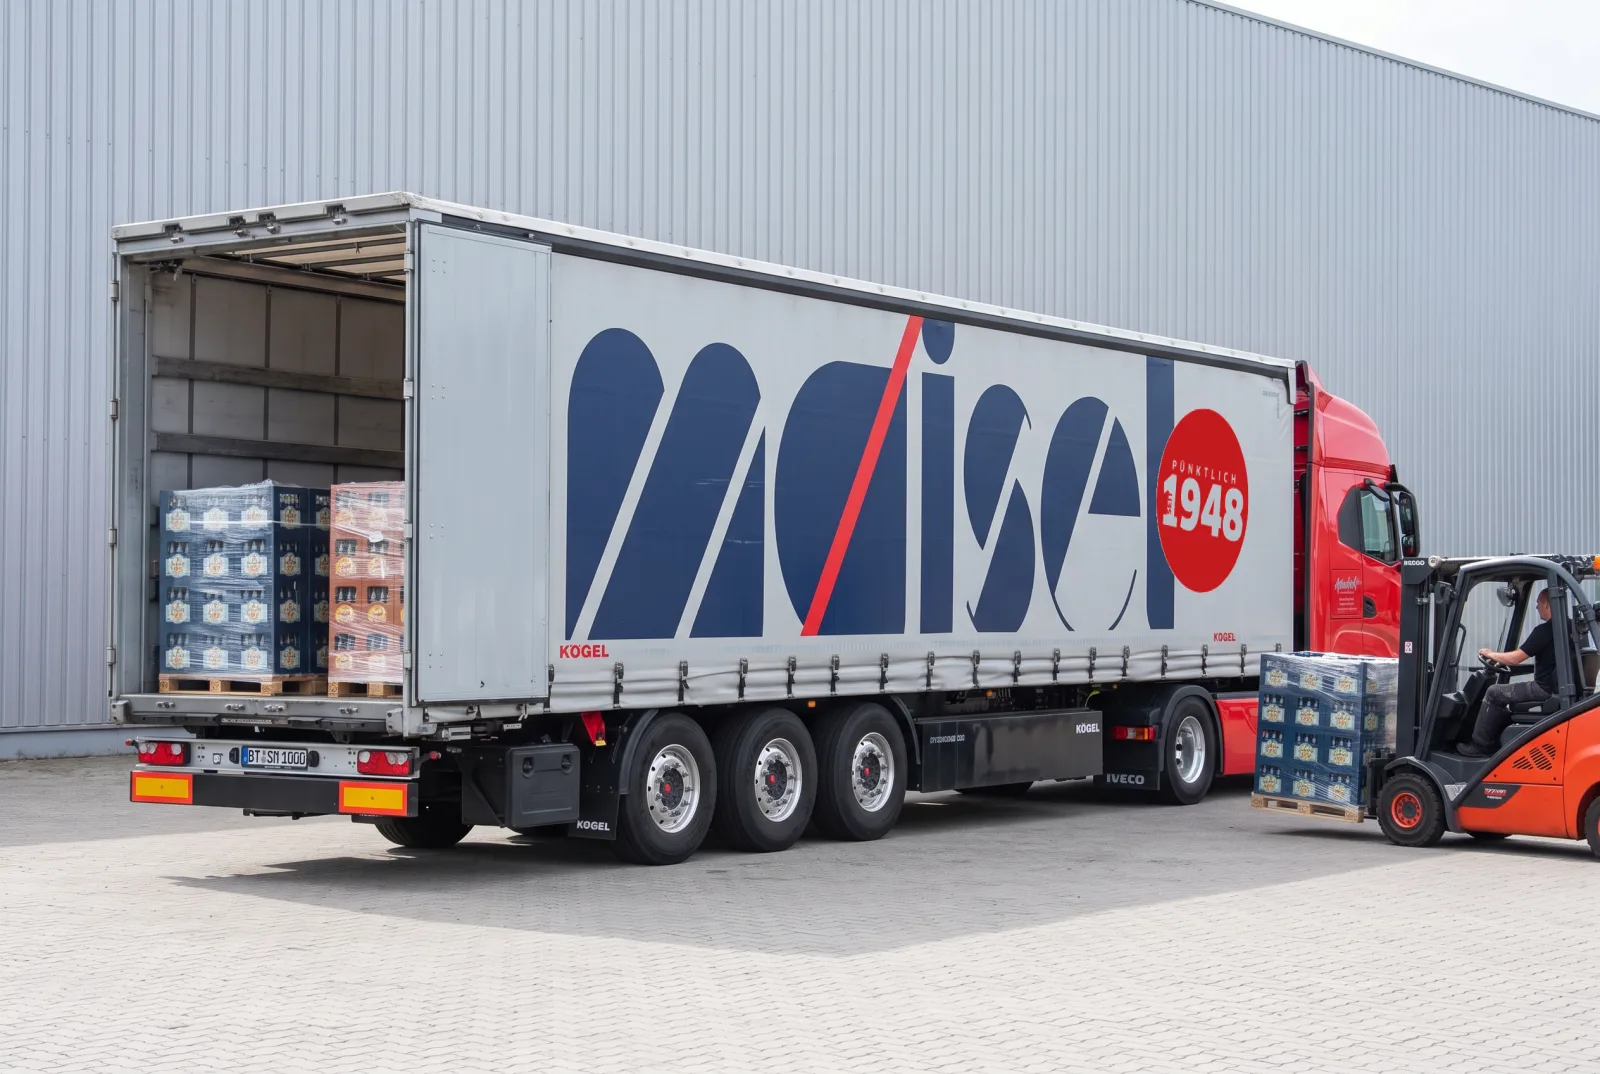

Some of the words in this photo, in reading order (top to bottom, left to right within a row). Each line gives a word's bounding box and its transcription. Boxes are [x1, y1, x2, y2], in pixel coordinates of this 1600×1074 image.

[1172, 459, 1237, 485] PÜNKTLICH
[1162, 474, 1244, 542] 1948
[248, 750, 260, 763] BT
[281, 751, 306, 765] 1000
[1106, 773, 1145, 785] IVECO
